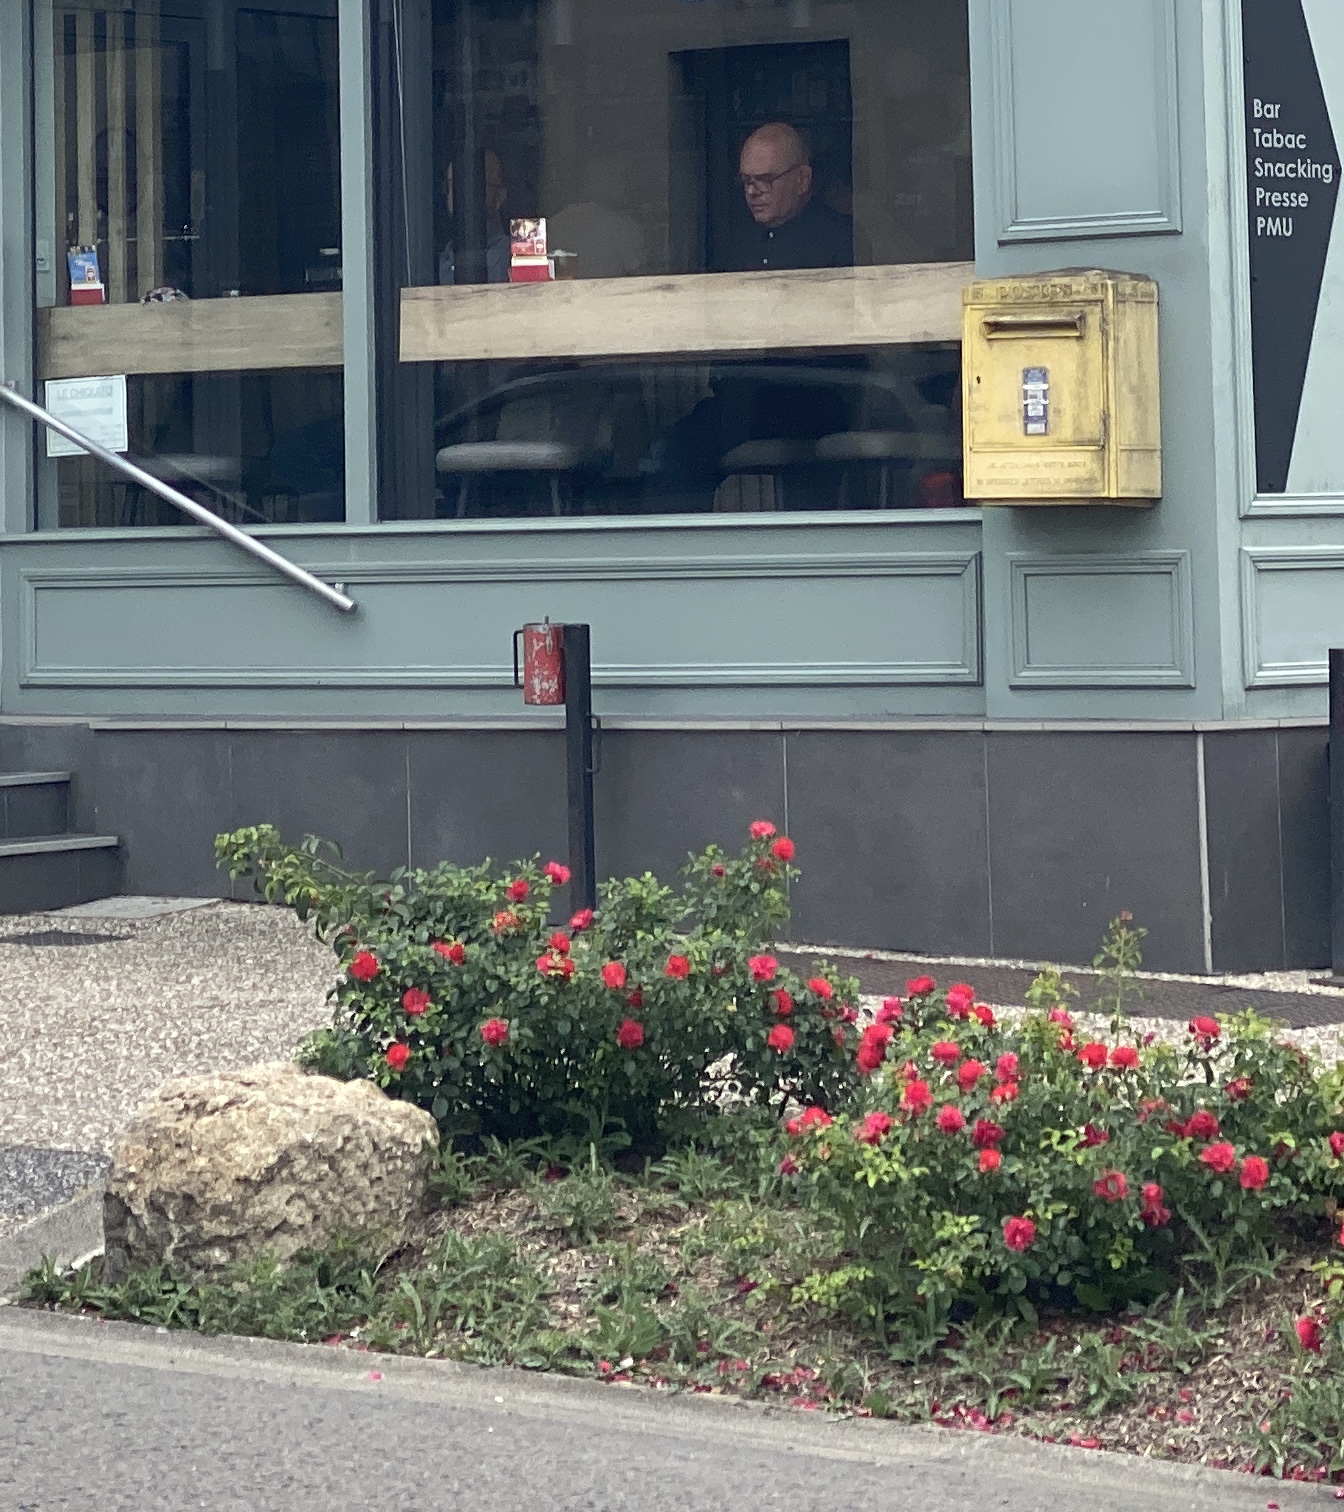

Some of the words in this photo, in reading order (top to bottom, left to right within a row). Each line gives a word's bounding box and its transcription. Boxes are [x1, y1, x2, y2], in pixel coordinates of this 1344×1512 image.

[1253, 99, 1280, 119] Bar
[1253, 128, 1307, 149] Tabac
[1254, 157, 1333, 183] Snacking
[1256, 187, 1309, 207] Presse
[1257, 216, 1293, 237] PMU
